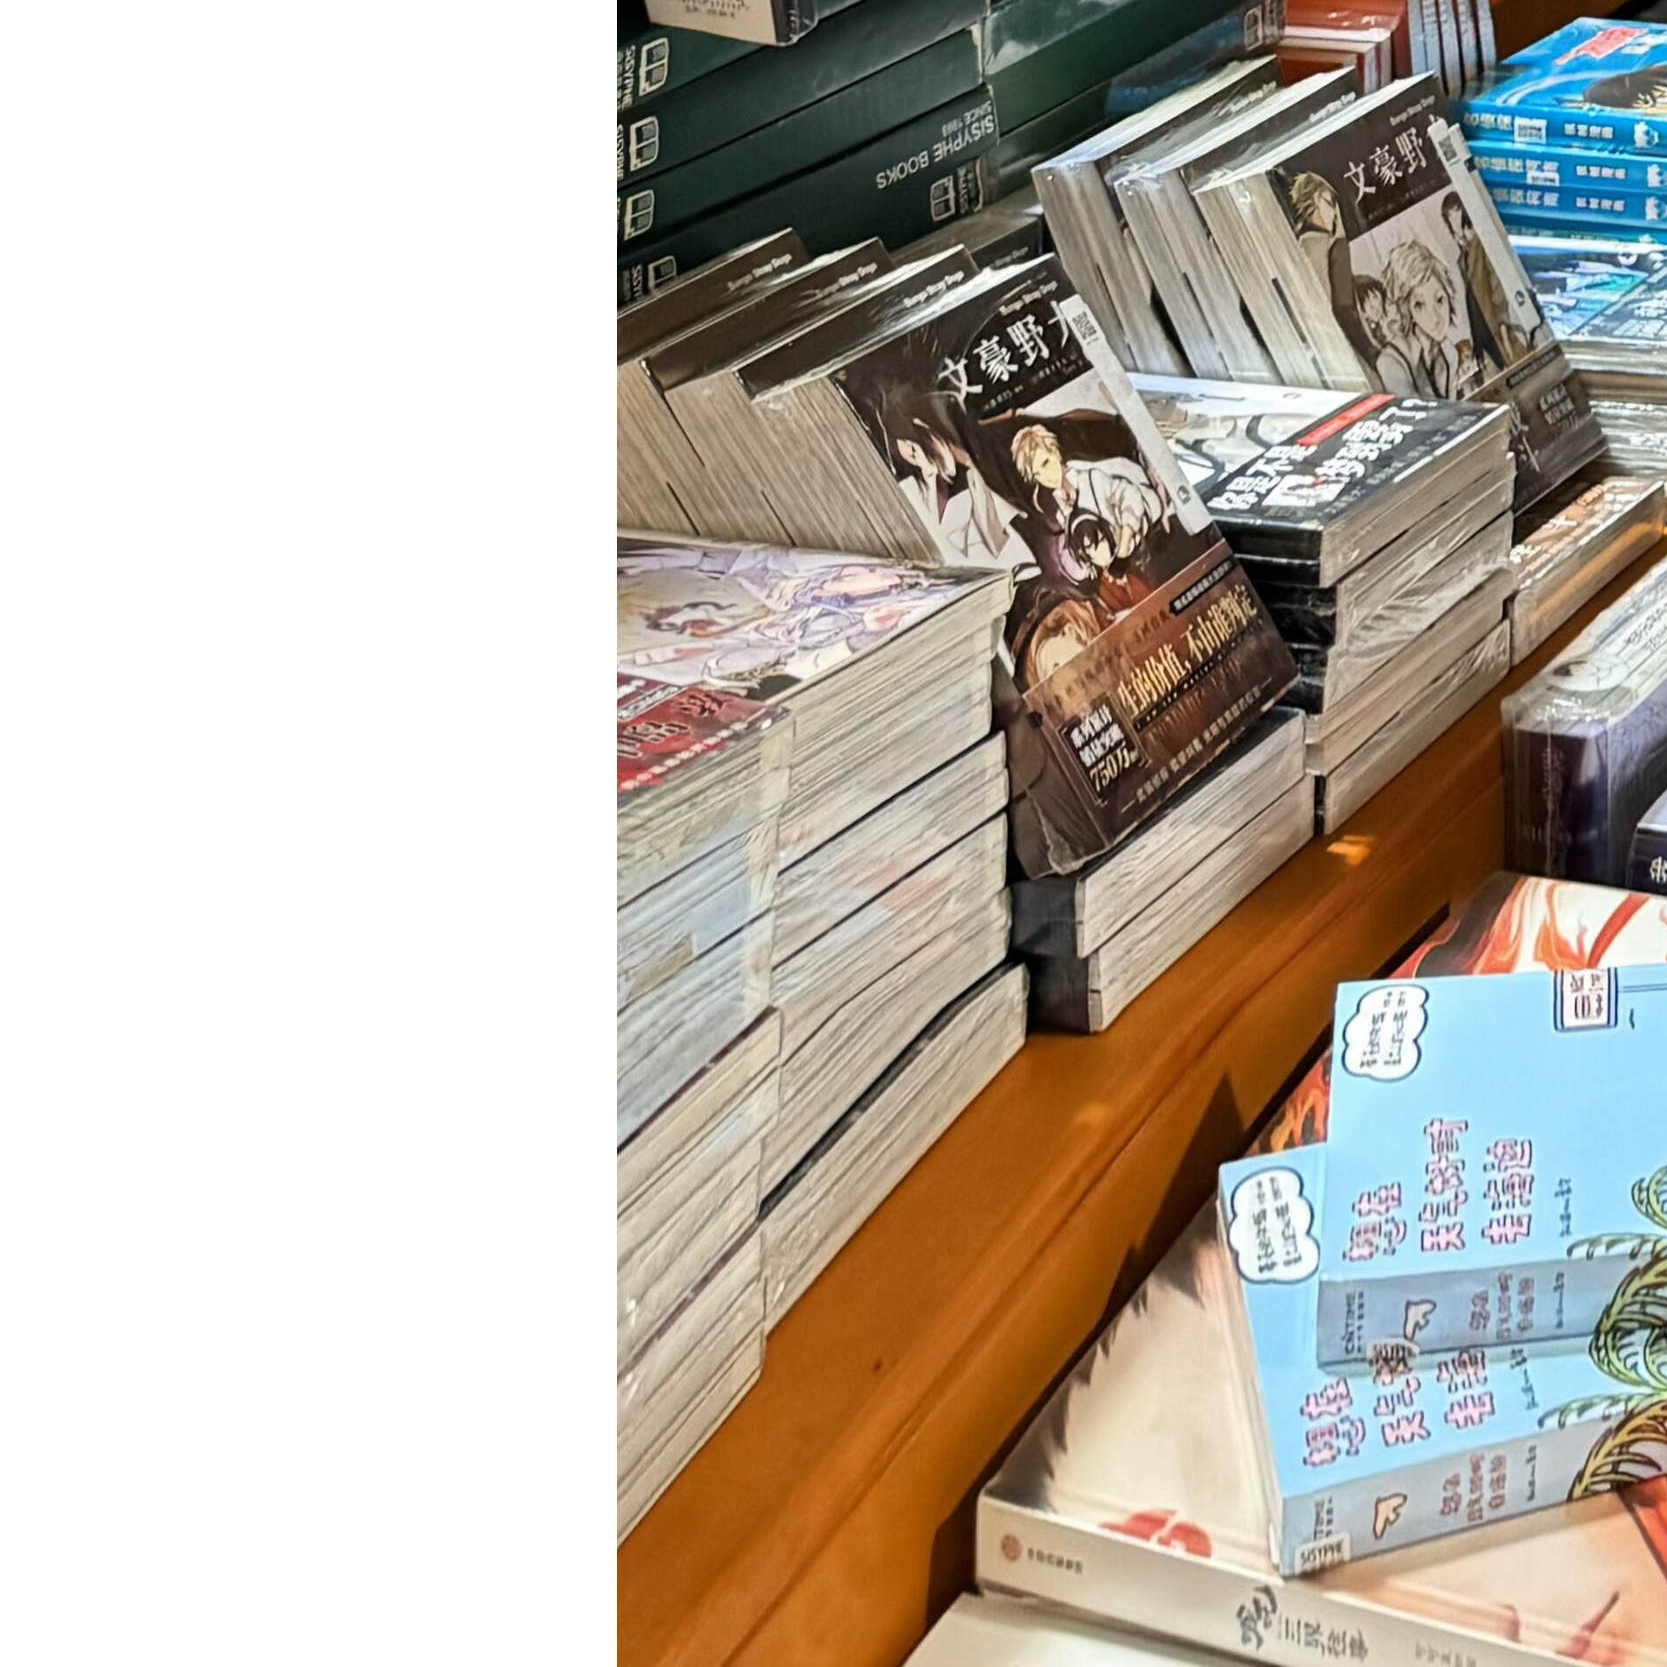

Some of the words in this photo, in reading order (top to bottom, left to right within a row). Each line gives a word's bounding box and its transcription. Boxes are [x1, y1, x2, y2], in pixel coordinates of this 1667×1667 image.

[876, 150, 930, 189] BOOKS
[932, 114, 995, 163] SISYPHE
[1343, 114, 1437, 205] 文豪野
[1342, 1182, 1403, 1261] 想在
[1418, 1118, 1468, 1253] 天气好时
[1481, 1137, 1537, 1247] 去海边
[1300, 1377, 1367, 1467] 想在
